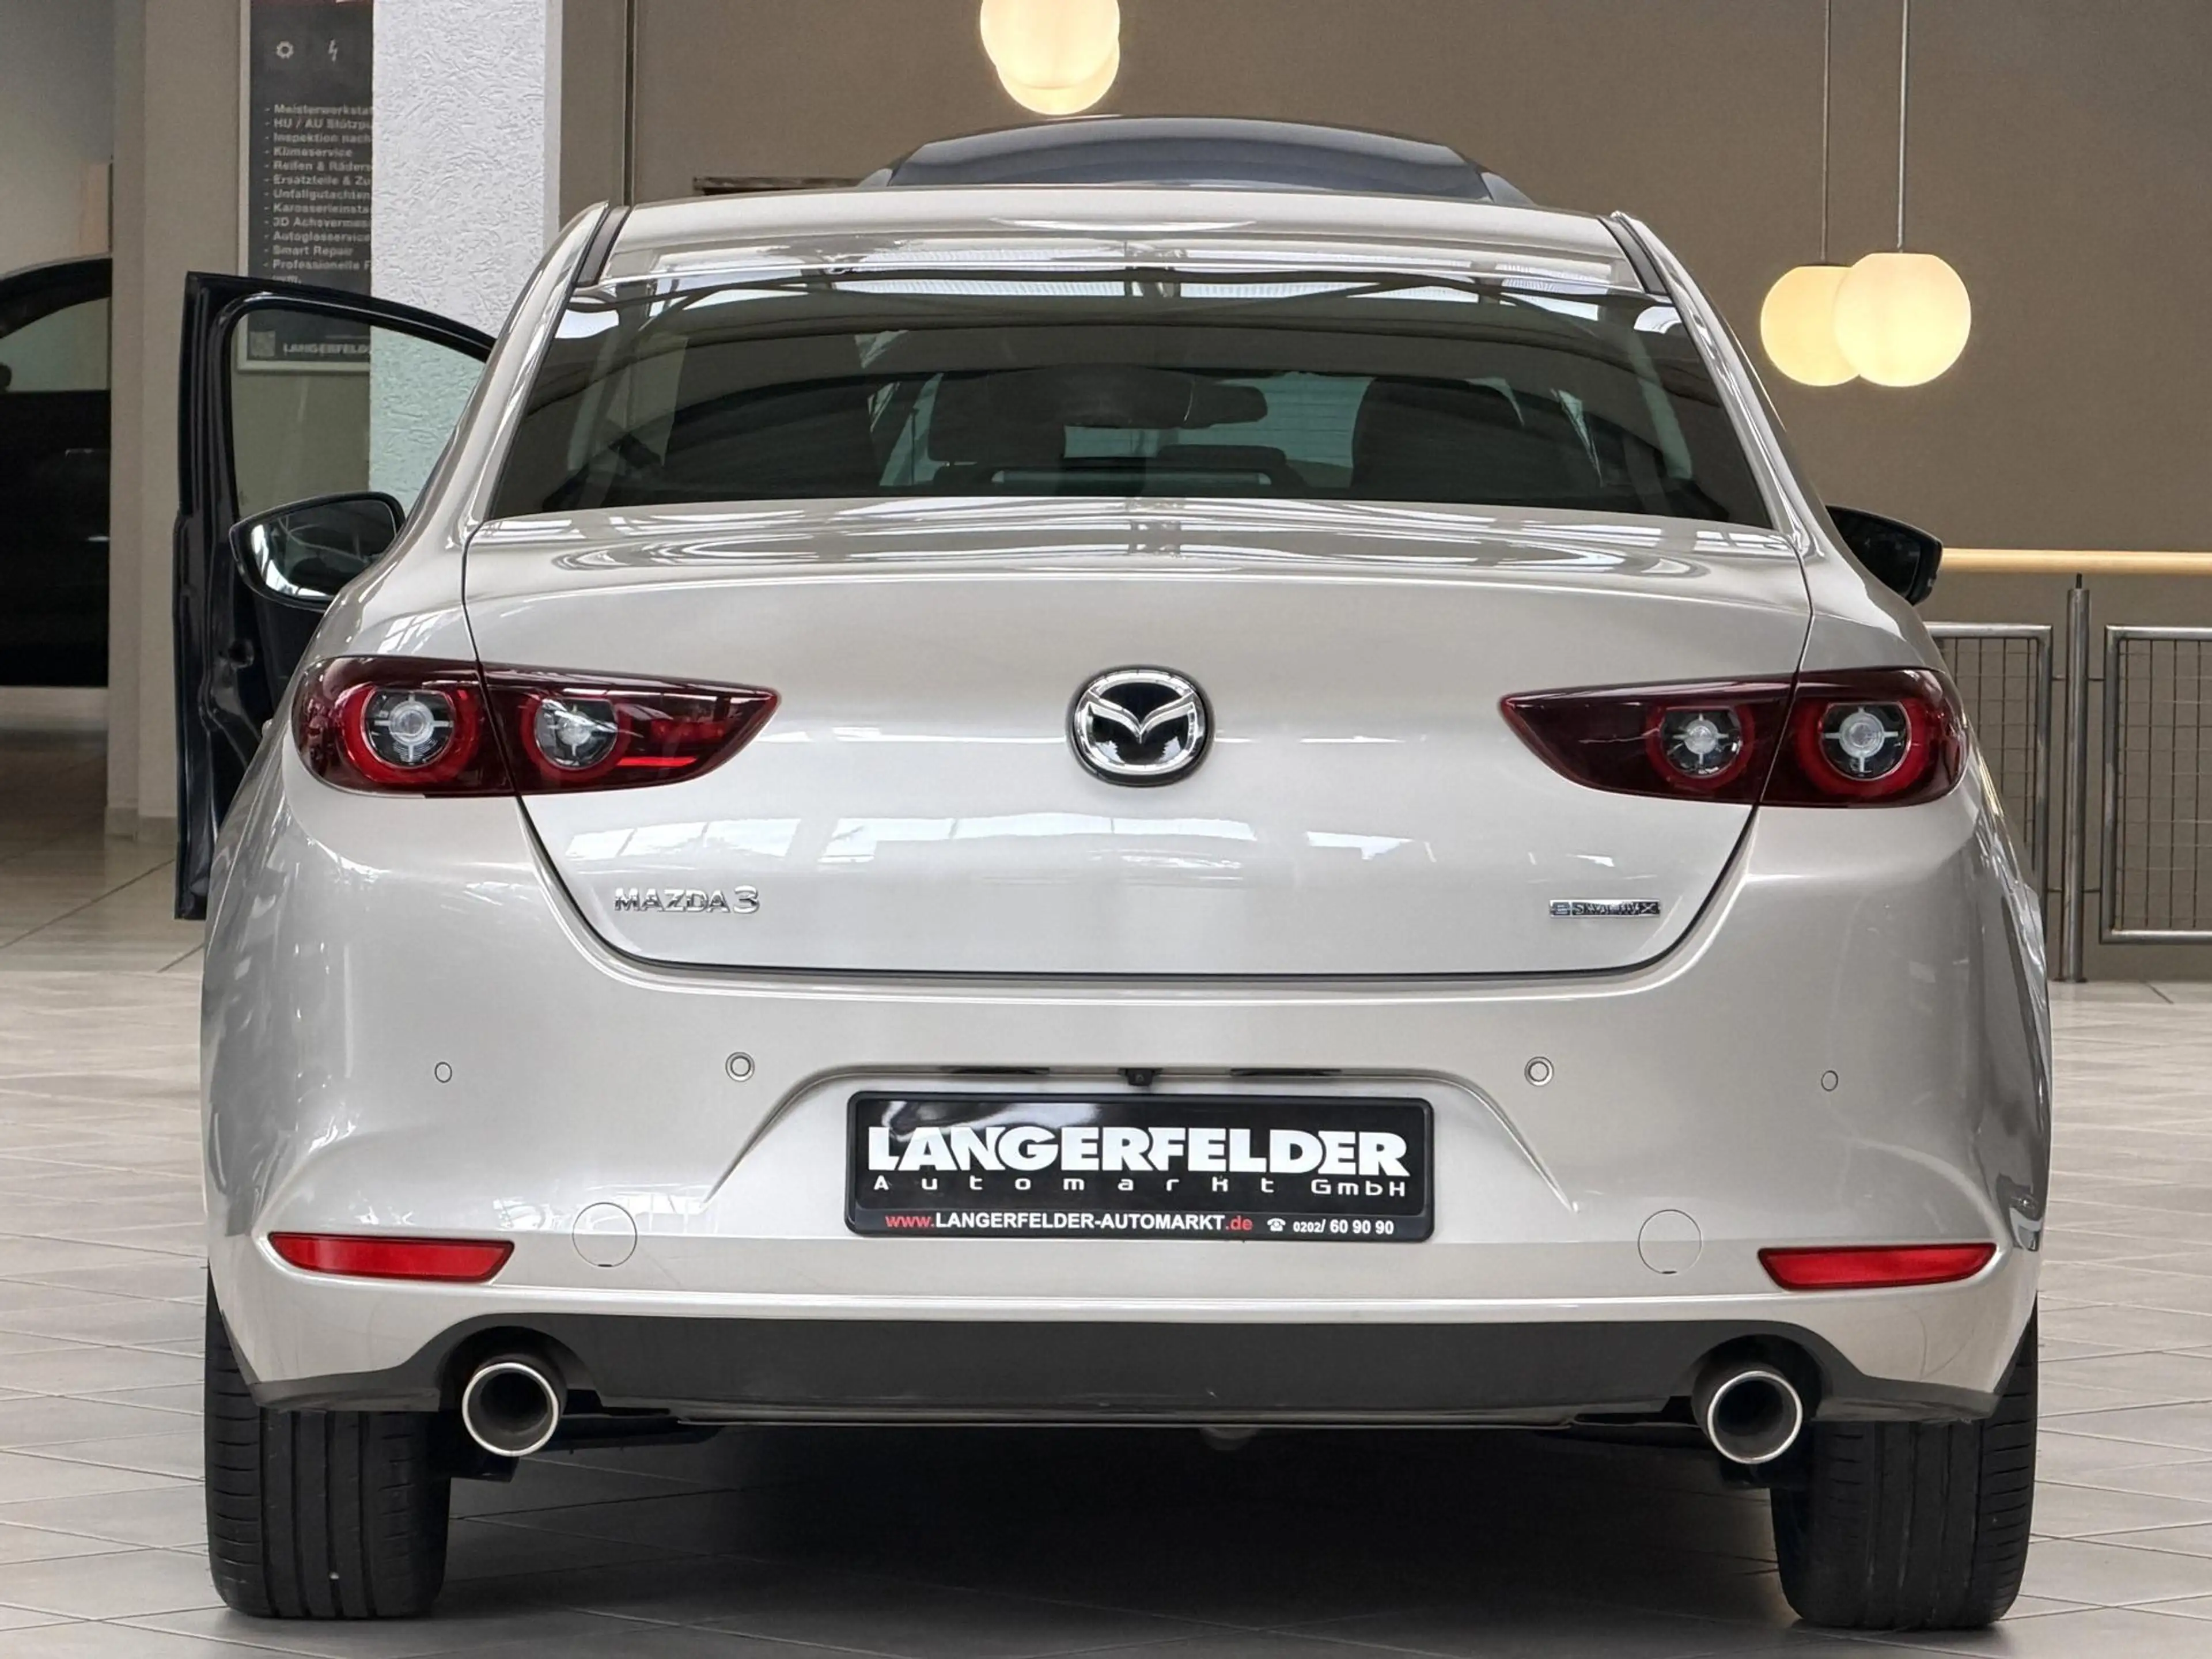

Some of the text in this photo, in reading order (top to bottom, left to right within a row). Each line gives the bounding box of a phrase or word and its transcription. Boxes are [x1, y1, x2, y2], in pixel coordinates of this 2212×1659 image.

[274, 119, 291, 128] HU
[305, 119, 323, 128] AU
[273, 132, 338, 143] Inspektion
[273, 147, 353, 157] Klimaservice
[273, 161, 312, 171] Reifen
[317, 162, 325, 171] &
[273, 175, 338, 184] Ersatzteile
[342, 176, 351, 185] &
[273, 189, 370, 200] Unfallgutachten
[273, 217, 290, 227] 3D
[273, 245, 353, 257] Smart Repair
[273, 259, 359, 270] Professionelle
[869, 1126, 1410, 1176] LANGERFELDER
[1311, 1179, 1406, 1197] GmbH
[885, 1212, 1395, 1235] www.LANGERFELDER-AUTOMARKT.de 0202/ 60 90 90
